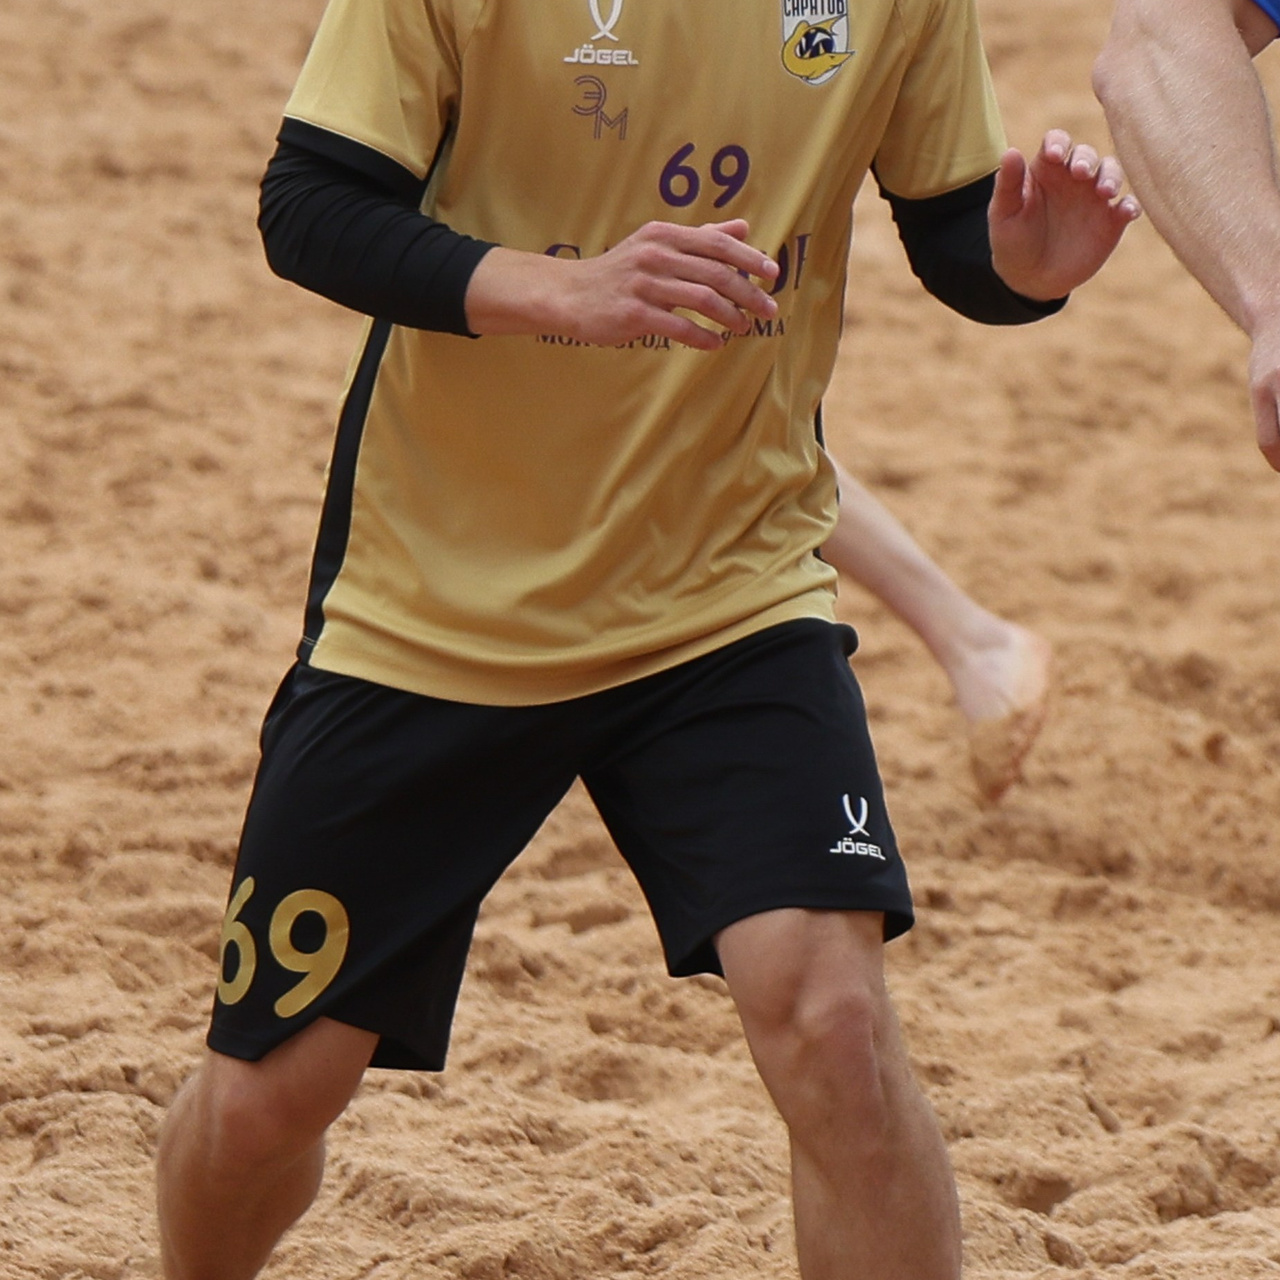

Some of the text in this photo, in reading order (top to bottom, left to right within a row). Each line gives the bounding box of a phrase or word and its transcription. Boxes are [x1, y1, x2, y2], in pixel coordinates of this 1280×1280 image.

[563, 43, 640, 66] JÖGEL
[658, 141, 750, 209] 69
[829, 837, 887, 861] JÖGEL
[217, 875, 350, 1019] 69
